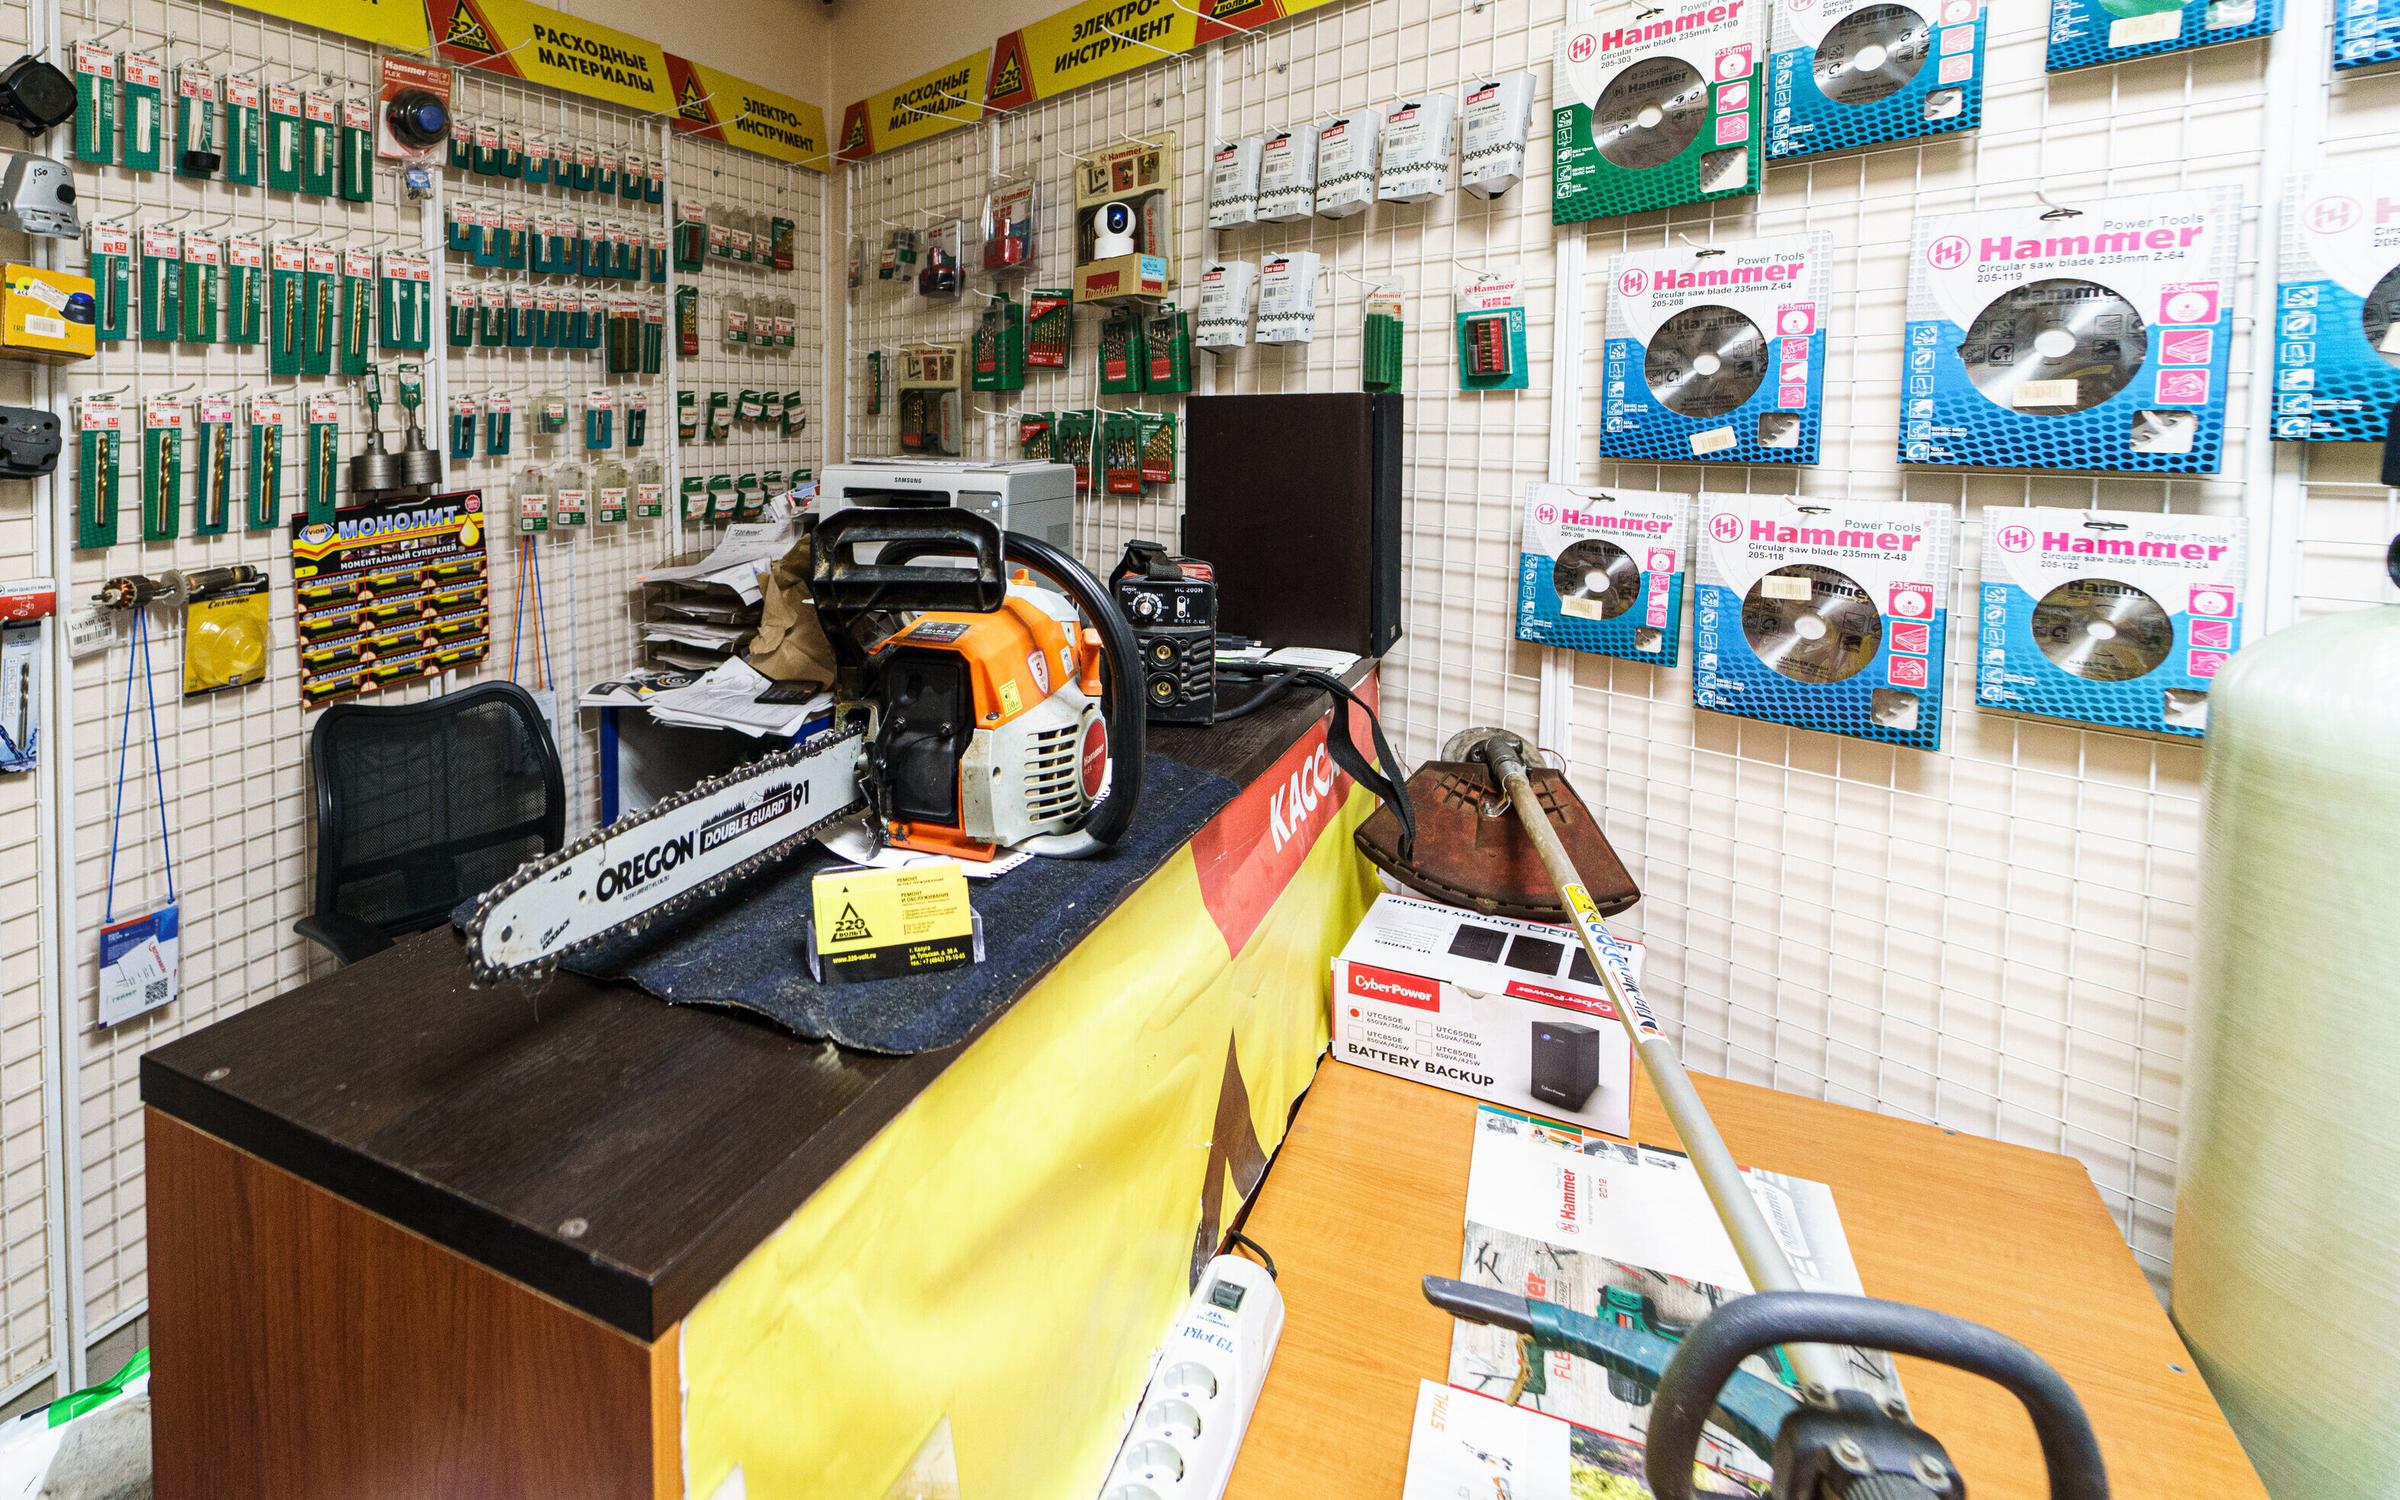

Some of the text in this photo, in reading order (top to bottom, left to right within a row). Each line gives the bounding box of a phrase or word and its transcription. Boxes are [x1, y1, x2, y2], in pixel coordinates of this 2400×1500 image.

[1822, 5, 1853, 16] 205-112
[1071, 0, 1162, 43] ЭЛЕКТРО-
[1602, 0, 1744, 52] Hammer
[533, 23, 648, 72] РАСХОДНЫЕ
[1054, 12, 1175, 74] ИНСТРУМЕНТ
[1600, 19, 1738, 61] Circular saw blade 235mm Z-100
[385, 60, 427, 77] Hammer
[538, 46, 654, 93] МАТЕРИАЛЫ
[1600, 56, 1632, 69] 205-303
[385, 69, 401, 78] FLEX
[893, 68, 971, 111] РАСХОДНЫЕ
[1628, 70, 1688, 94] Hammer
[1467, 91, 1493, 104] Saw chain
[742, 96, 802, 126] ЭЛЕКТРО-
[888, 89, 968, 131] МАТЕРИАЛЫ
[1390, 112, 1414, 123] Saw chain
[735, 115, 814, 152] ИНСТРУМЕНТ
[1332, 127, 1344, 136] chain
[1108, 147, 1142, 161] Hammer
[1001, 188, 1031, 204] Hammer
[2103, 214, 2204, 230] Power Tools
[1978, 226, 2203, 262] Hammer
[1737, 252, 1805, 266] Power Tools
[1977, 251, 2185, 274] Circular saw blade 235mm Z-64
[1653, 263, 1804, 290] Hammer
[1977, 272, 2022, 283] 205-119
[1473, 282, 1515, 294] Hammer
[1652, 291, 1685, 299] Circular
[1707, 287, 1732, 295] blade
[1735, 284, 1768, 293] 235mm
[1771, 282, 1791, 290] Z-64
[2160, 283, 2219, 292] 235mm
[1652, 299, 1684, 307] 205-208
[1778, 303, 1814, 311] 235mm
[338, 506, 458, 540] МОНОЛИТ
[1562, 509, 1672, 534] Hammer
[1624, 510, 1673, 520] Power Tools
[1561, 525, 1585, 533] Circular
[1602, 528, 1619, 536] blade
[1622, 530, 1645, 539] 190mm
[1845, 520, 1922, 533] Power Tools
[1750, 520, 1921, 552] Hammer
[2145, 531, 2228, 543] Power Tools
[1748, 543, 1907, 562] Circular saw blade 235mm Z-48
[2042, 531, 2229, 561] Hammer
[341, 544, 457, 570] МОМЕНТАЛЬНЫЙ СУПЕРКЛЕЙ
[443, 552, 484, 563] МОНОЛИТ
[1748, 552, 1784, 561] 205-118
[2041, 552, 2081, 562] Circular
[2108, 556, 2137, 566] blade
[2184, 560, 2209, 569] Z-24
[381, 562, 426, 575] МОНОЛИТ
[2041, 560, 2079, 570] 205-122
[314, 573, 362, 586] МОНОЛИТ
[444, 580, 485, 593] МОНОЛИТ
[1889, 582, 1933, 594] 235mm
[382, 591, 426, 605] МОНОЛИТ
[316, 604, 363, 619] МОНОЛИТ
[444, 608, 486, 621] МОНОЛИТ
[383, 621, 427, 635] МОНОЛИТ
[317, 634, 365, 650] МОНОЛИТ
[446, 636, 487, 649] МОНОЛИТ
[384, 650, 428, 665] МОНОЛИТ
[319, 665, 366, 681] МОНОЛИТ
[1084, 745, 1104, 765] Hammer
[596, 830, 694, 902] OREGON
[704, 816, 748, 849] DOUBLE
[750, 801, 784, 825] GUARD
[792, 779, 810, 812] 91
[1388, 898, 1520, 928] BATTERY BACKUP
[835, 918, 865, 932] 220
[1355, 975, 1432, 1002] CyberPower
[1516, 986, 1613, 1013] CyberPower
[1367, 1011, 1403, 1024] UTC650E
[1367, 1030, 1403, 1044] UTC850E
[1436, 1026, 1477, 1040] UTC650EI
[1436, 1045, 1476, 1059] UTC850EI
[1348, 1043, 1420, 1069] BATTERY
[1425, 1062, 1494, 1087] BACKUP
[1541, 1084, 1566, 1098] CyberPower
[1560, 1168, 1576, 1221] Hammer
[1599, 1178, 1608, 1198] 2012
[1182, 1325, 1215, 1342] Pilot
[1431, 1393, 1449, 1432] STIHL
